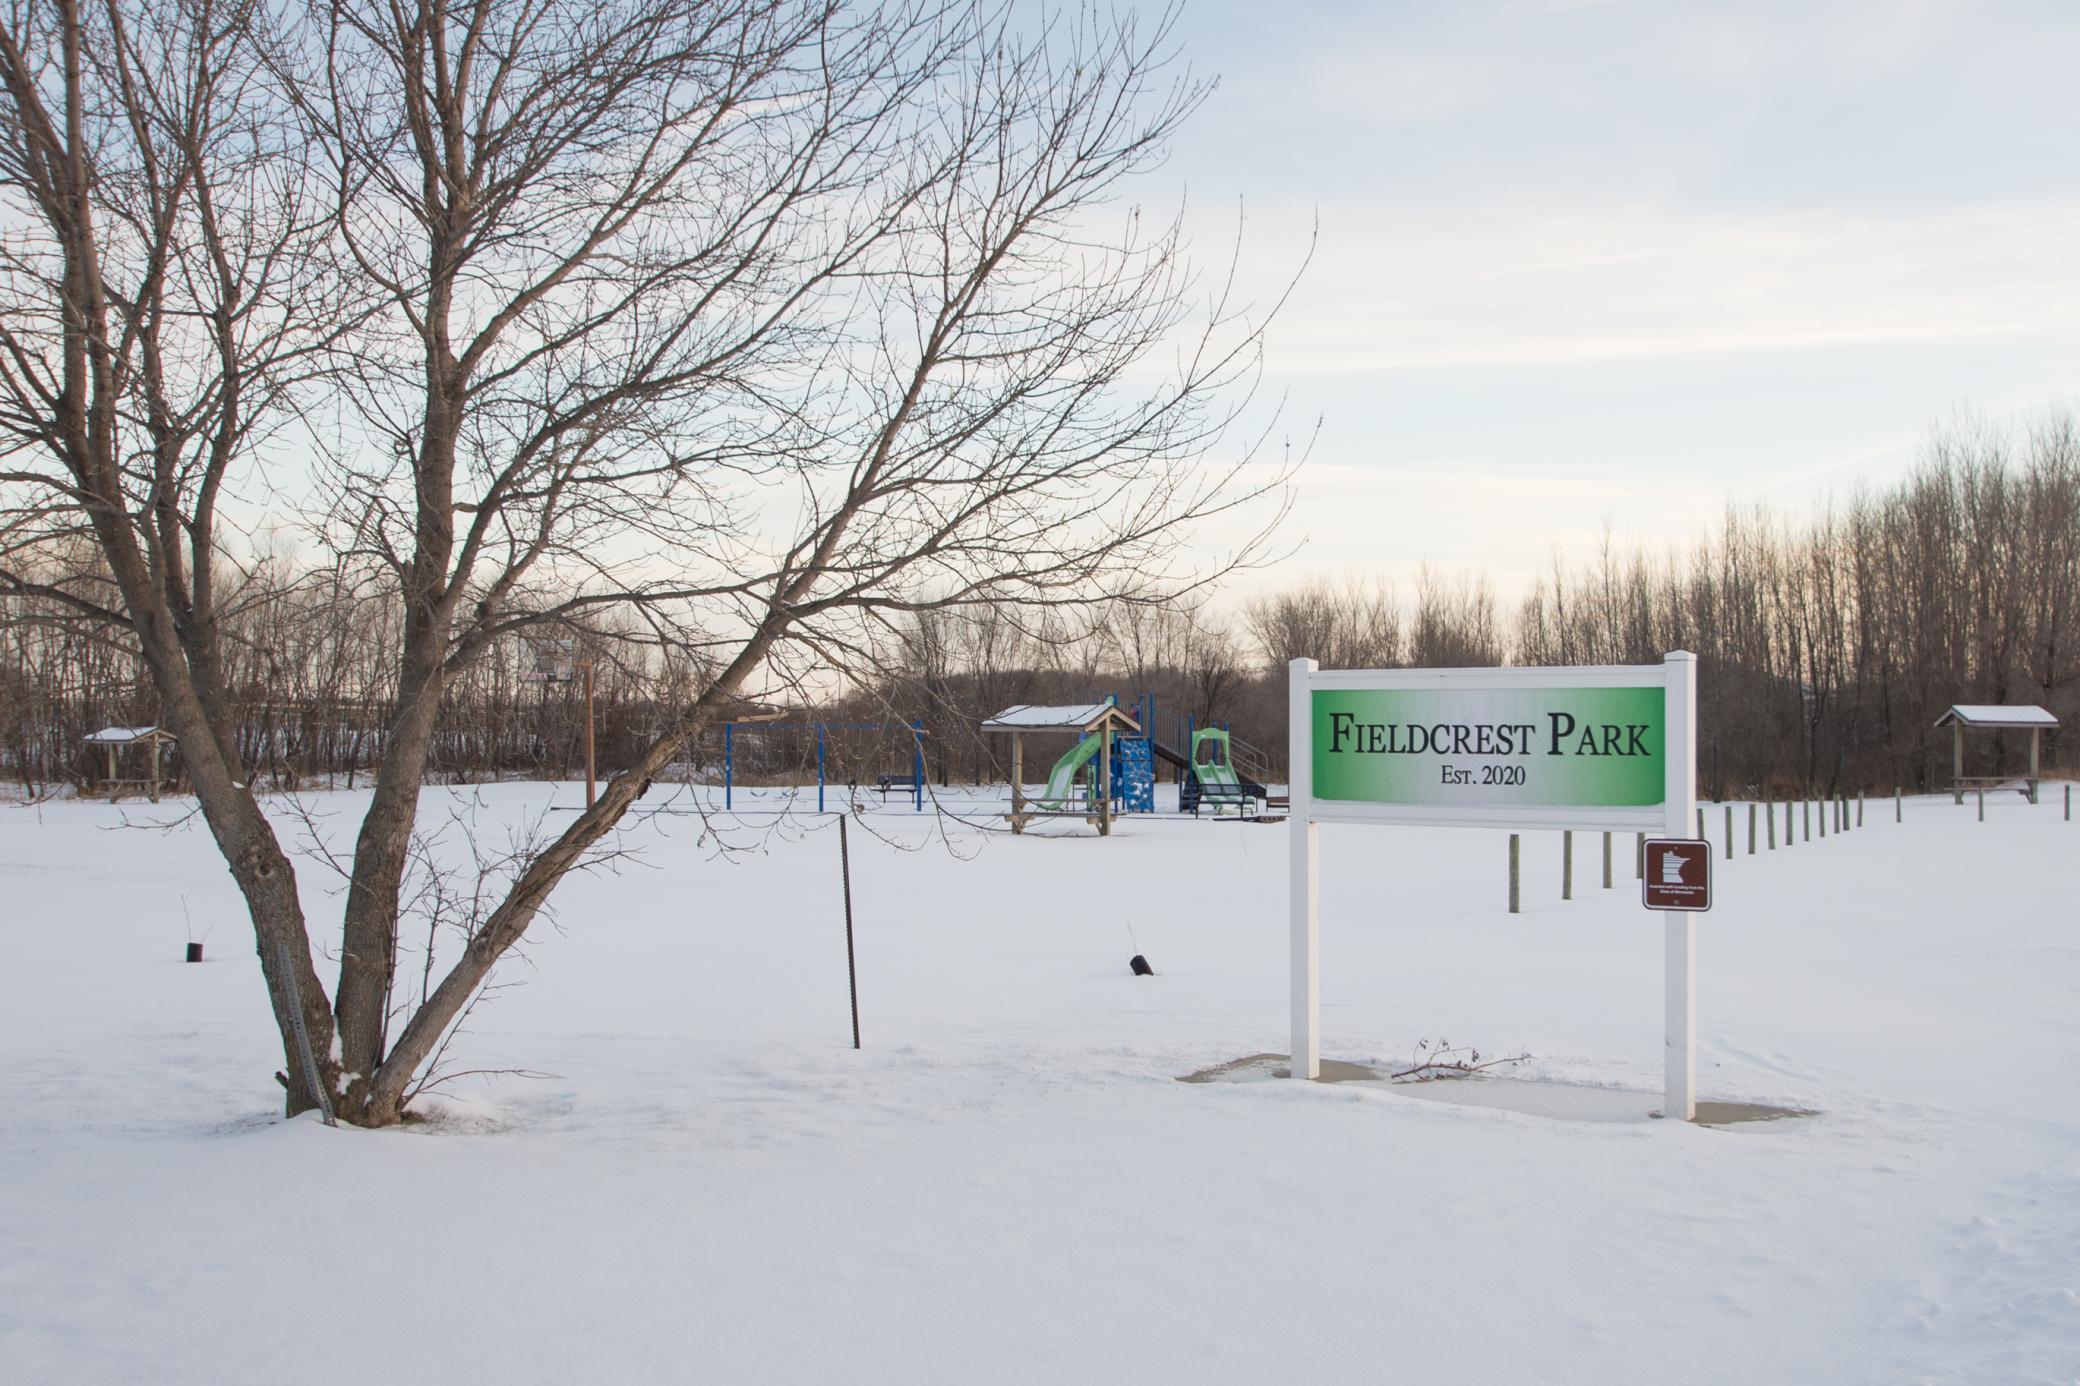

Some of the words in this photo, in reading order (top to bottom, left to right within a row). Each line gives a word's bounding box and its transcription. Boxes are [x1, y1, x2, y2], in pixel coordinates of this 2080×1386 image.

[1329, 712, 1536, 755] FIELDCREST
[1547, 712, 1651, 756] PARK
[1482, 765, 1526, 785] 2020
